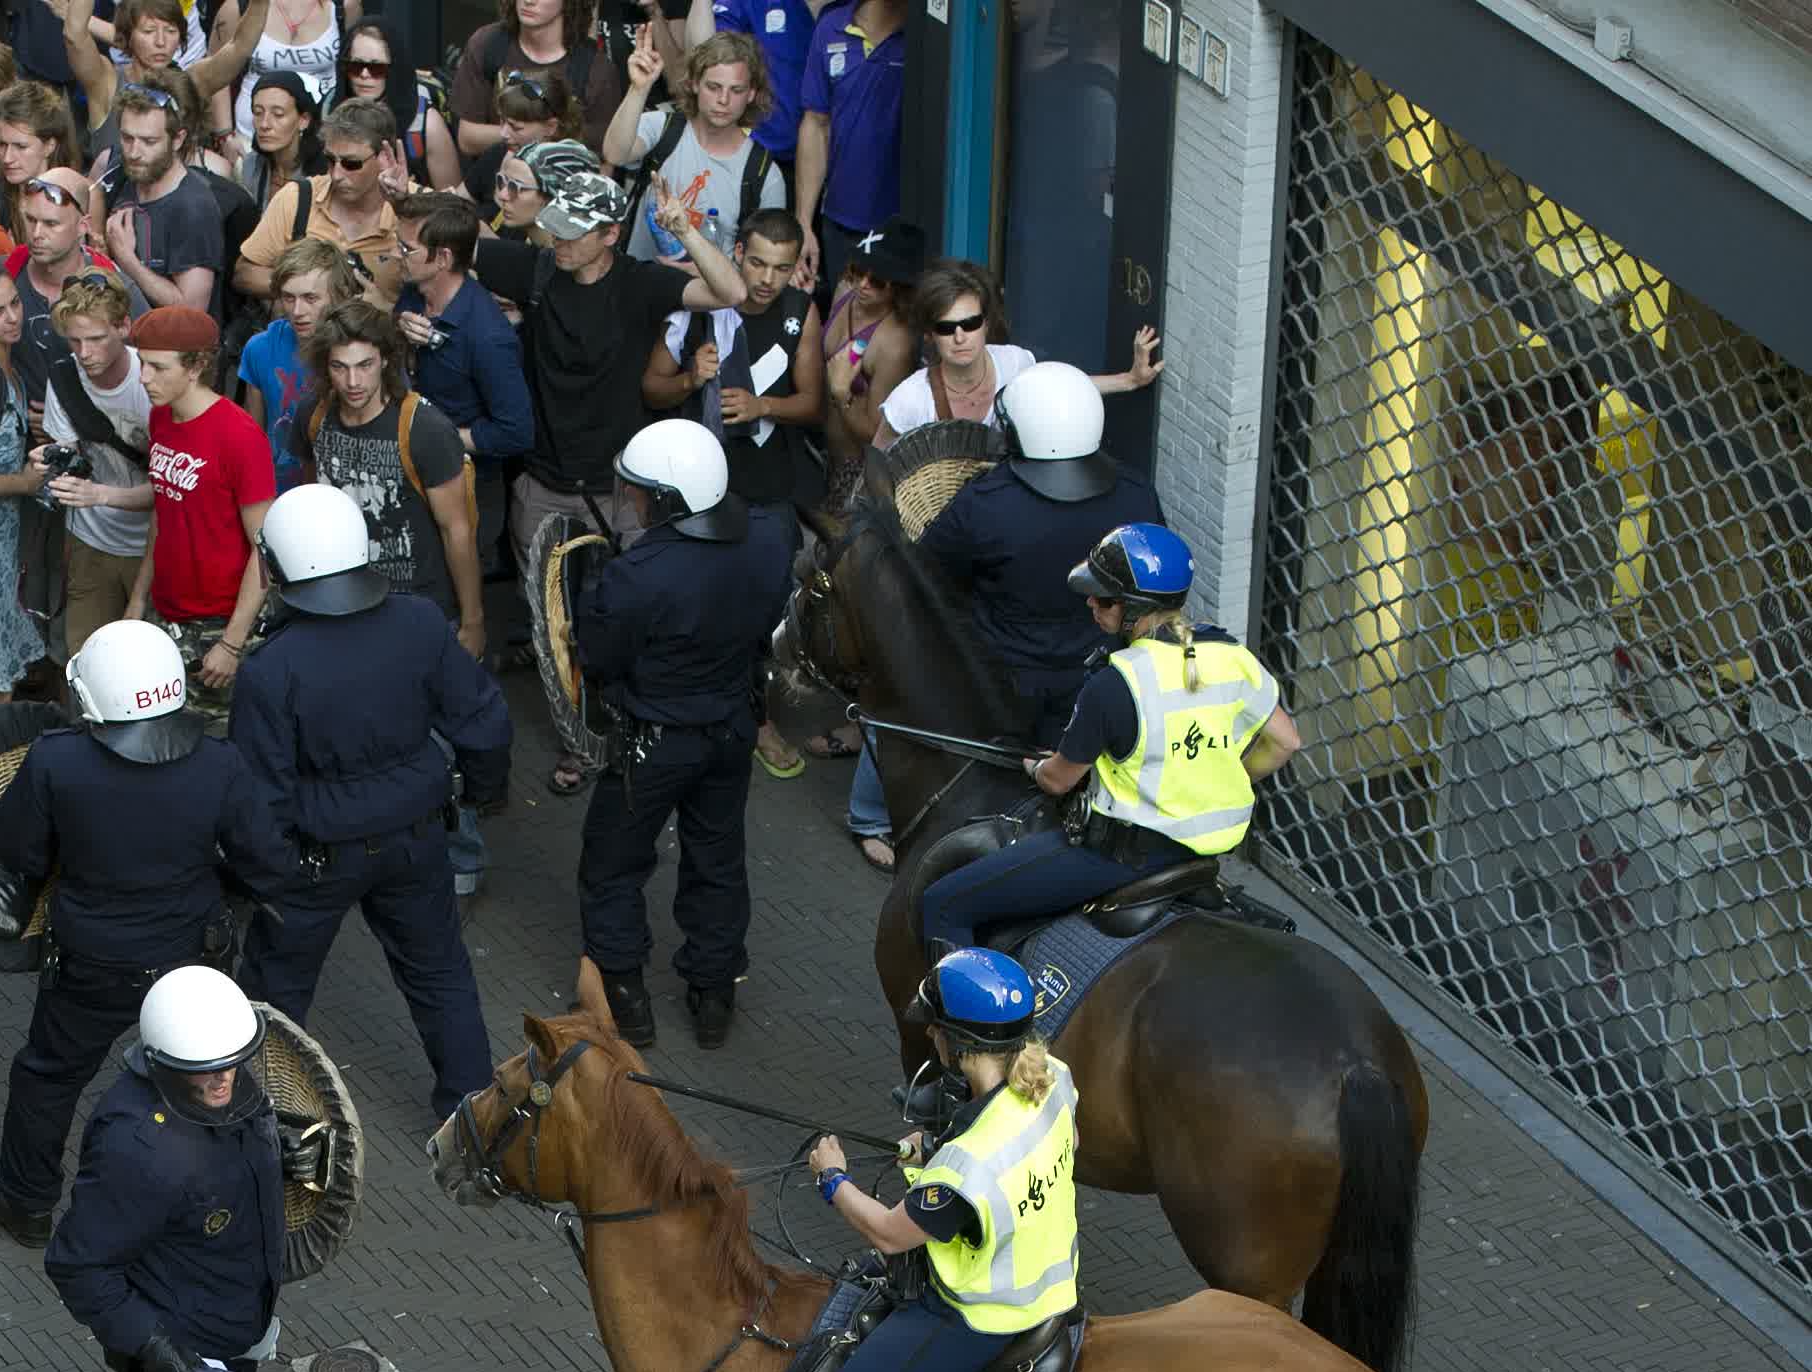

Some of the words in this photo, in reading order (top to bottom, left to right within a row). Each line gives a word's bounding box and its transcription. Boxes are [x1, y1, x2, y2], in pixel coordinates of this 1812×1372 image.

[135, 678, 182, 708] B140
[1172, 720, 1228, 760] POLI
[1017, 1138, 1071, 1217] POLITIE
